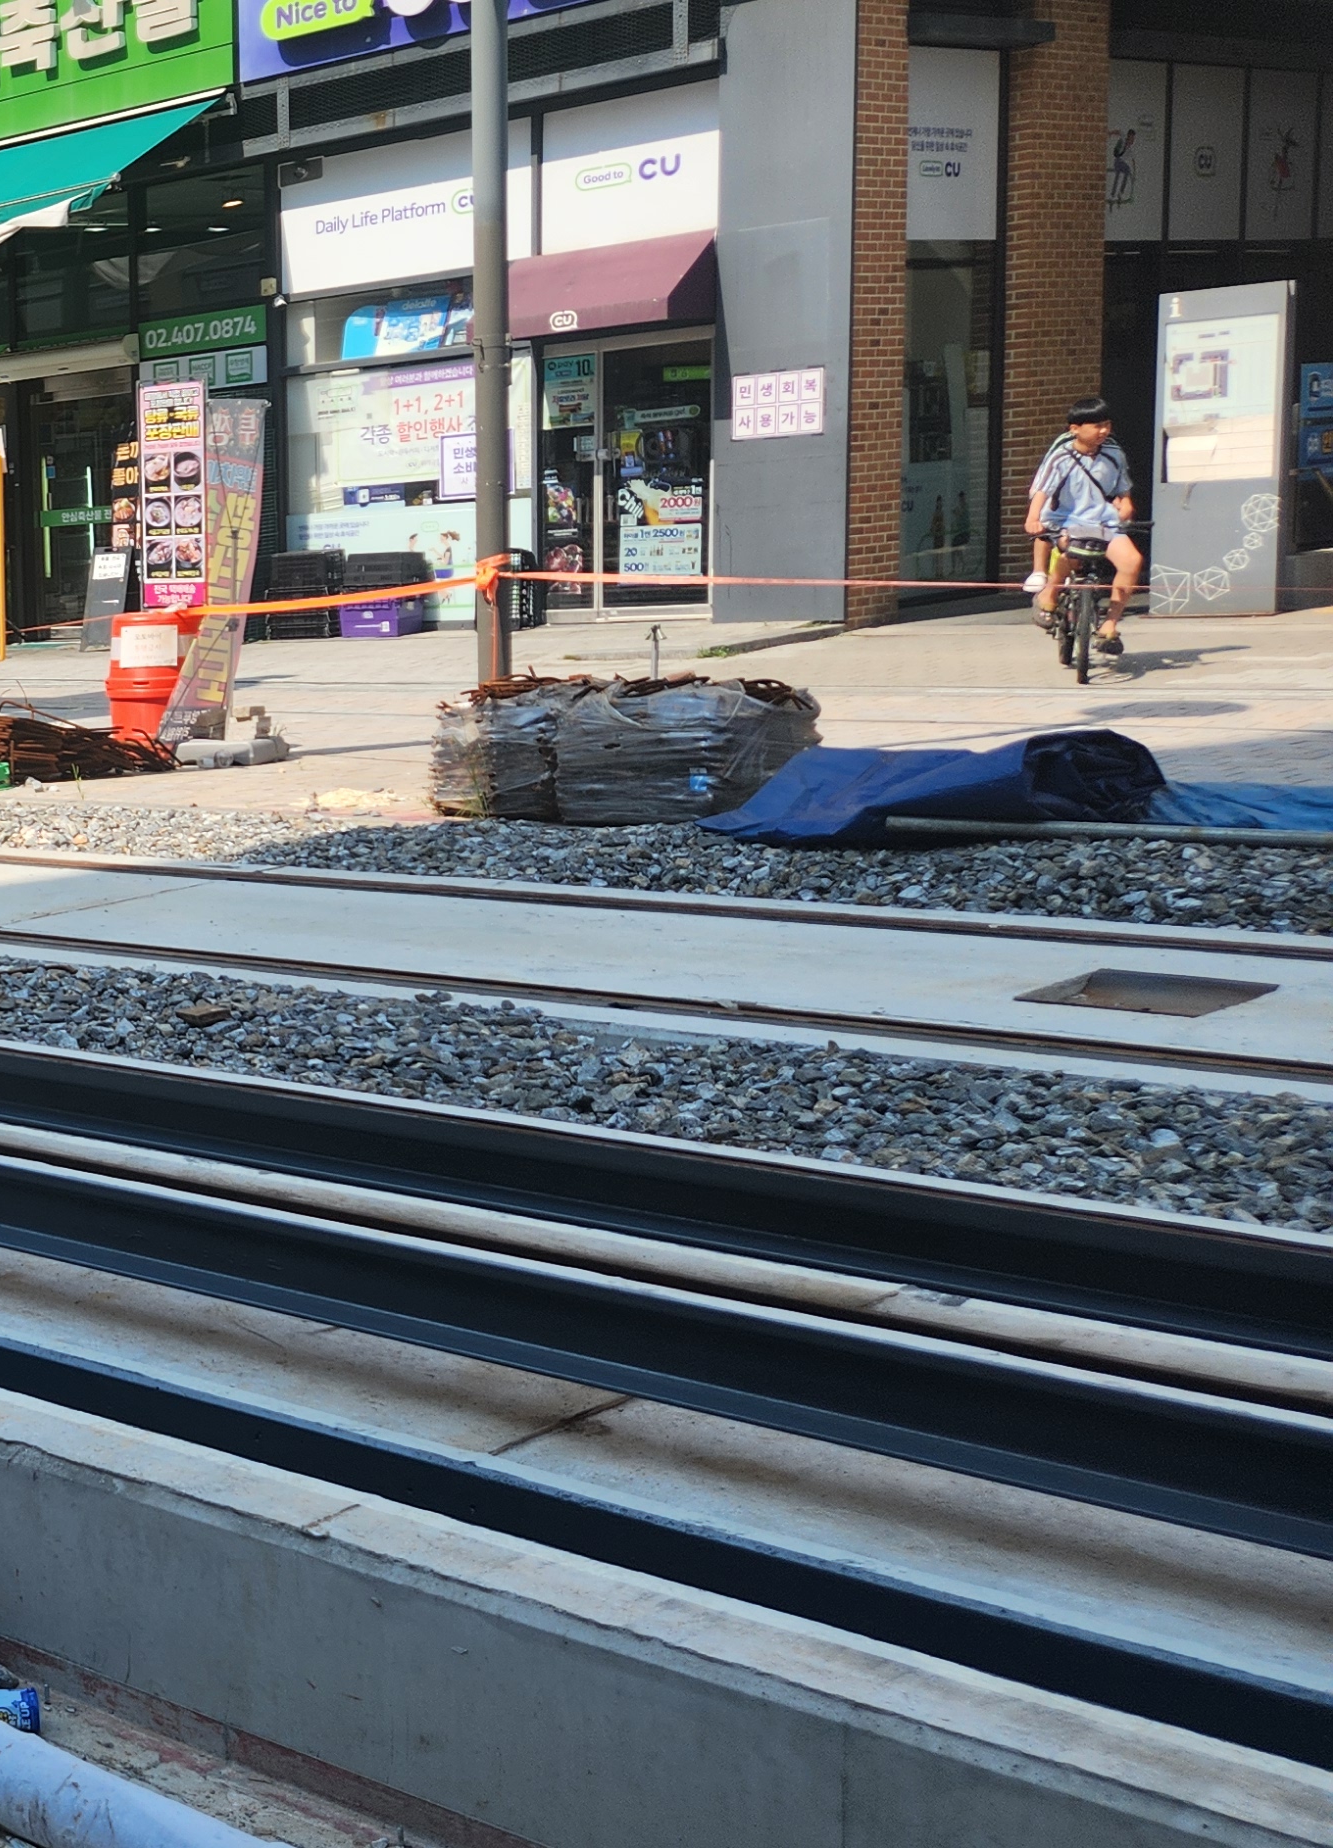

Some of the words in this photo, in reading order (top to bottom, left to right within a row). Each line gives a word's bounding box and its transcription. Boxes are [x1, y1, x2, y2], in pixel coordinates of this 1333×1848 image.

[276, 1, 328, 29] Nice
[583, 171, 611, 184] Good
[613, 170, 624, 179] to
[638, 153, 682, 180] CU
[945, 161, 961, 177] CU
[315, 216, 349, 235] Daily
[352, 210, 378, 228] Life
[381, 202, 446, 223] Platform
[145, 315, 257, 349] 02.407.0874
[434, 391, 465, 411] 2+1
[360, 424, 393, 446] 각종
[396, 416, 463, 443] 할인행사
